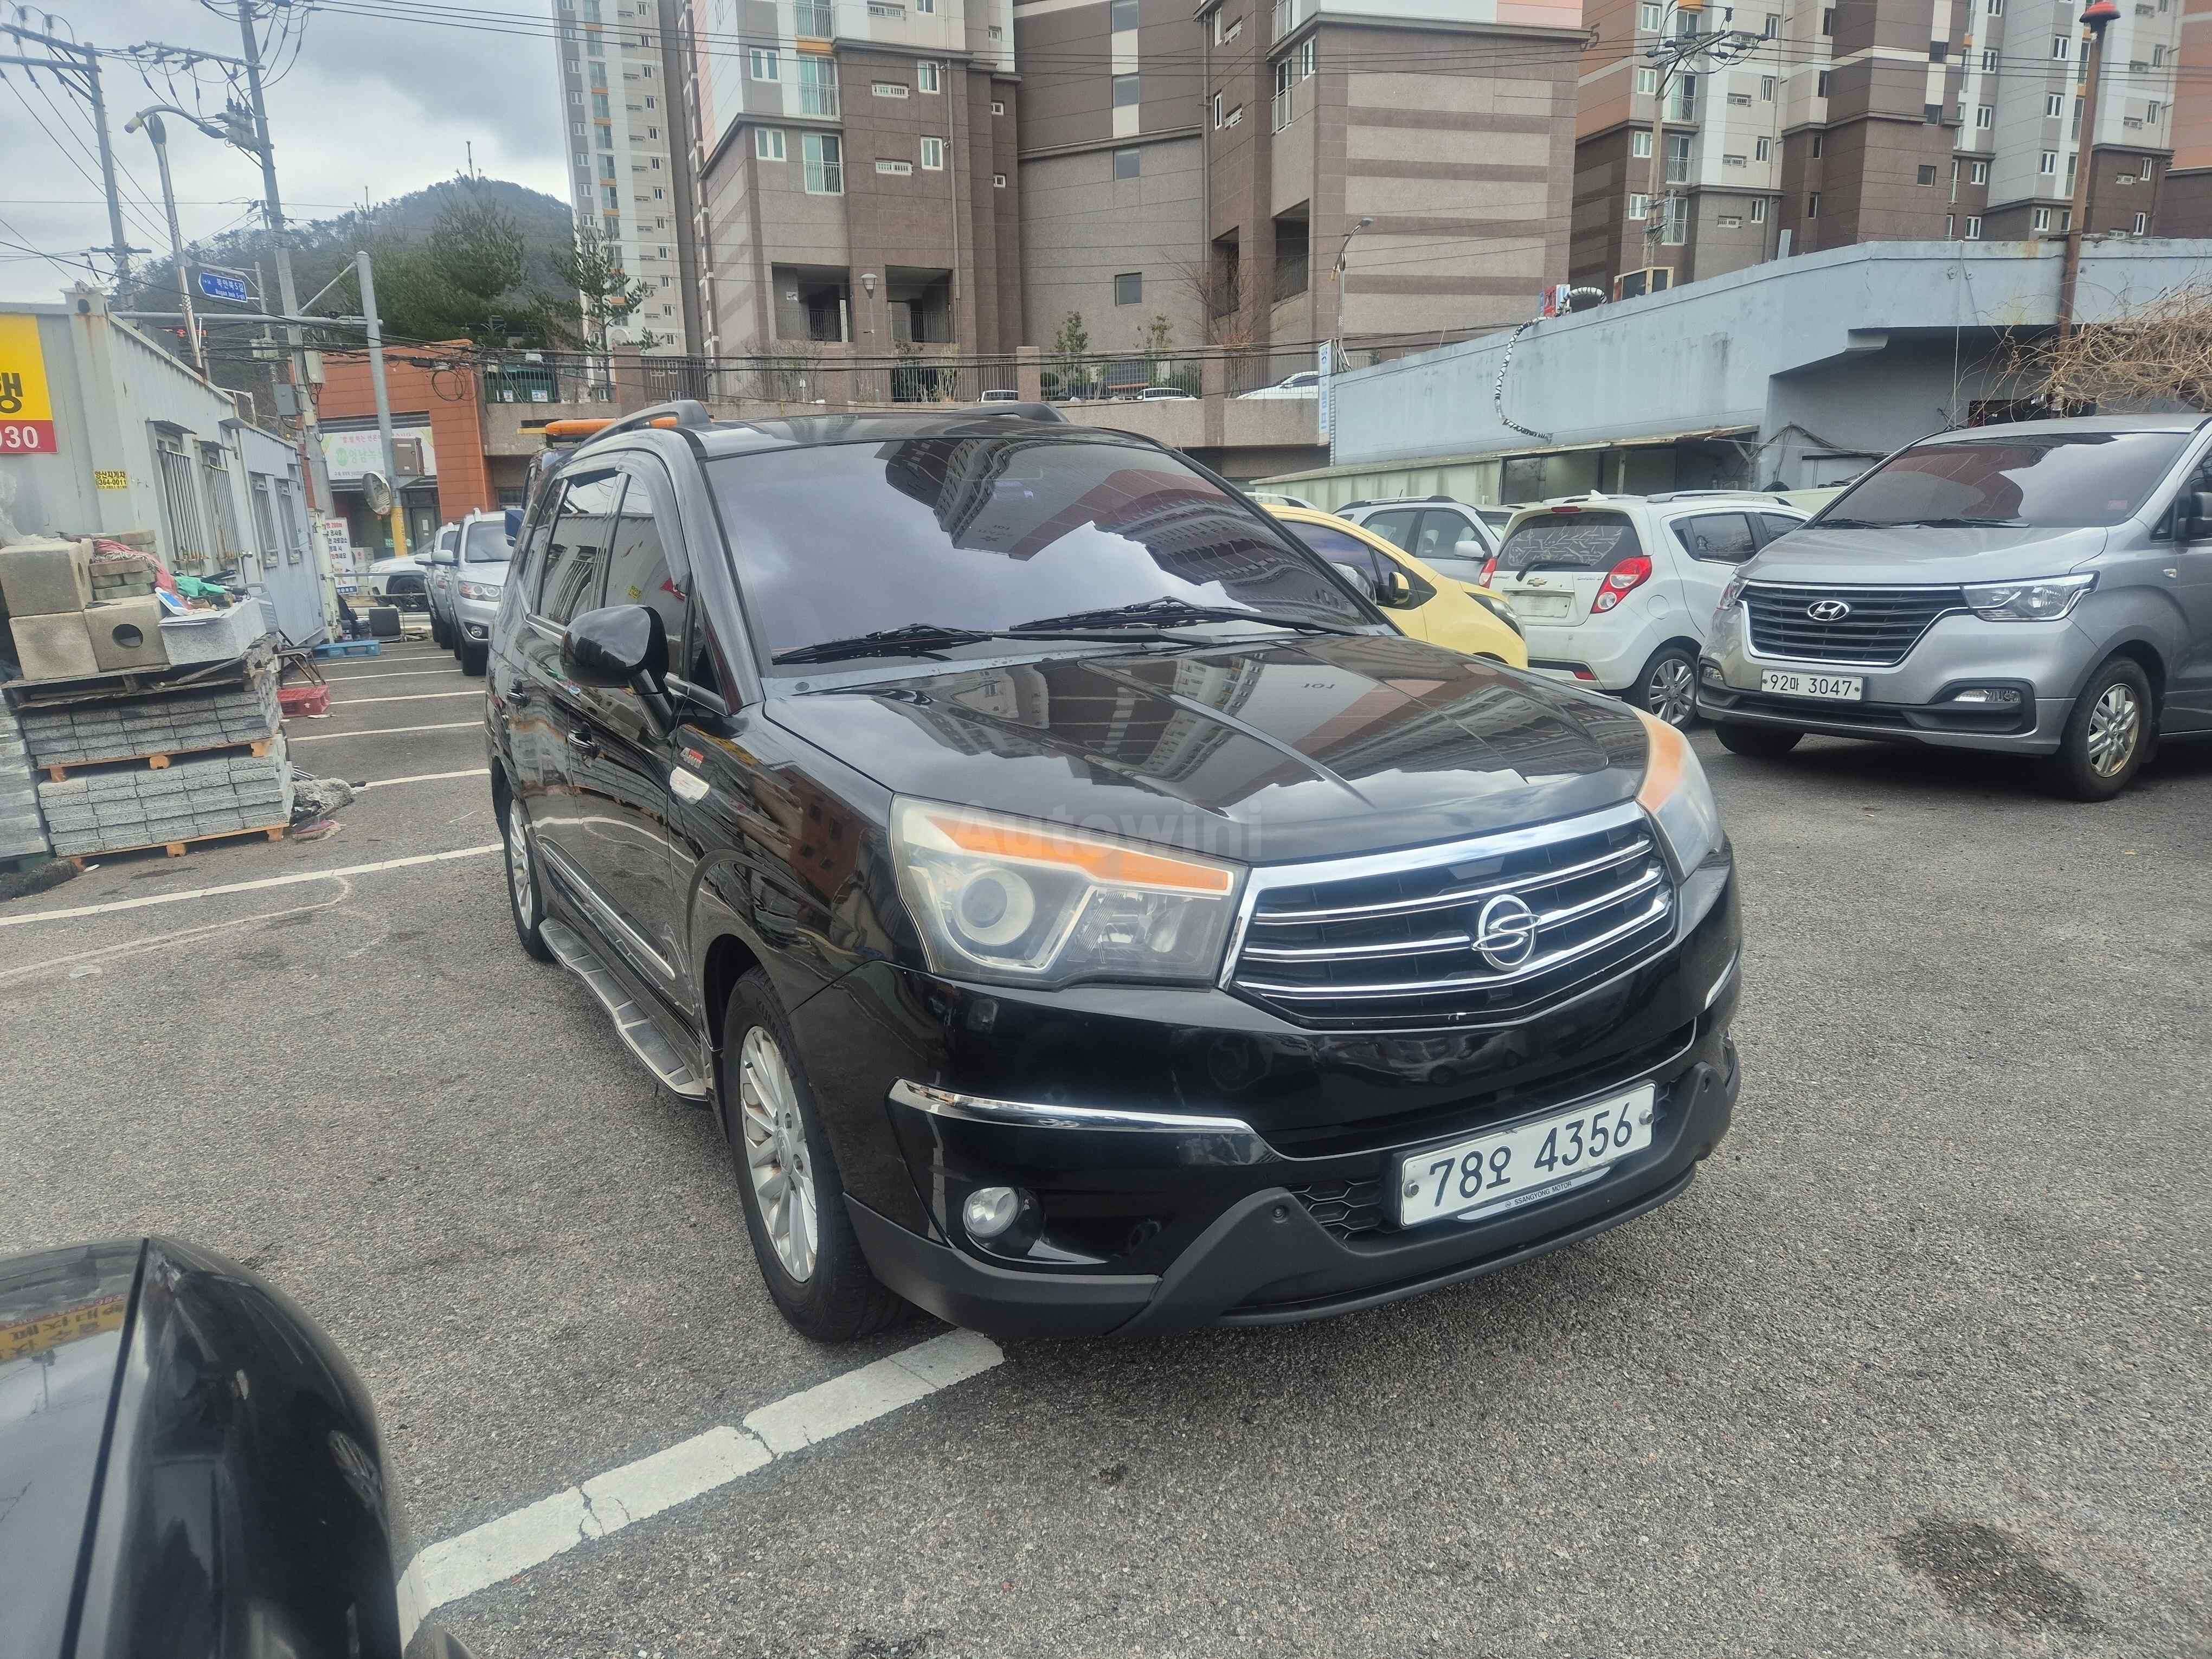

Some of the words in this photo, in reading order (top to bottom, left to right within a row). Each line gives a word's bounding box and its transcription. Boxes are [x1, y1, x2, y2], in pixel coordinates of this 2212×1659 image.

[0, 426, 38, 448] 30
[1770, 674, 1799, 691] 92마
[1808, 678, 1853, 696] 3047
[1429, 1146, 1512, 1207] 78오
[1534, 1102, 1632, 1172] 4356
[1514, 1189, 1550, 1205] SSANGYONG
[1552, 1181, 1572, 1193] MOTOR
